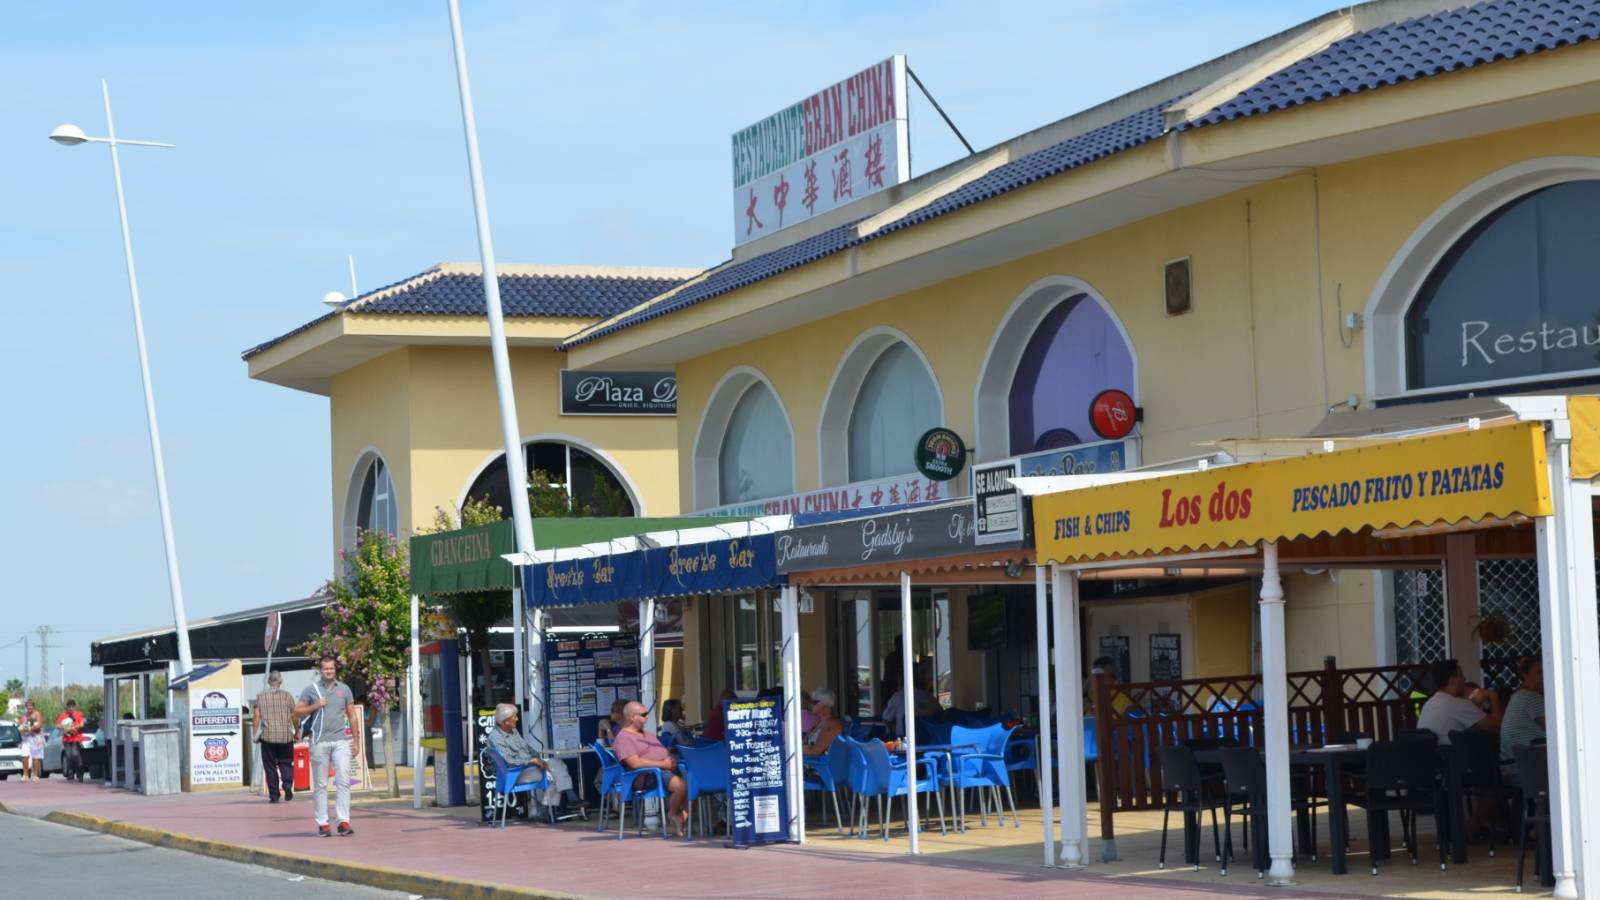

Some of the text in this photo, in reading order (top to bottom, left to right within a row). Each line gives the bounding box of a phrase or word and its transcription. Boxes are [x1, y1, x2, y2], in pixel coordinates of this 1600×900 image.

[732, 60, 897, 189] RESTAURANTE GRAN CHINA
[1461, 320, 1600, 367] Restau
[575, 376, 644, 402] Plaza
[925, 461, 953, 476] SMOOTH
[976, 472, 986, 494] SE
[1292, 461, 1504, 513] PESCADO FRITO Y PATATAS
[1159, 481, 1253, 528] Los dos
[1054, 509, 1131, 540] FISH & CHIPS
[729, 540, 755, 568] Bar
[777, 534, 830, 567] Restaurante
[861, 518, 914, 561] Gadsby's
[194, 716, 237, 725] DIFERENTE
[209, 746, 225, 756] 66
